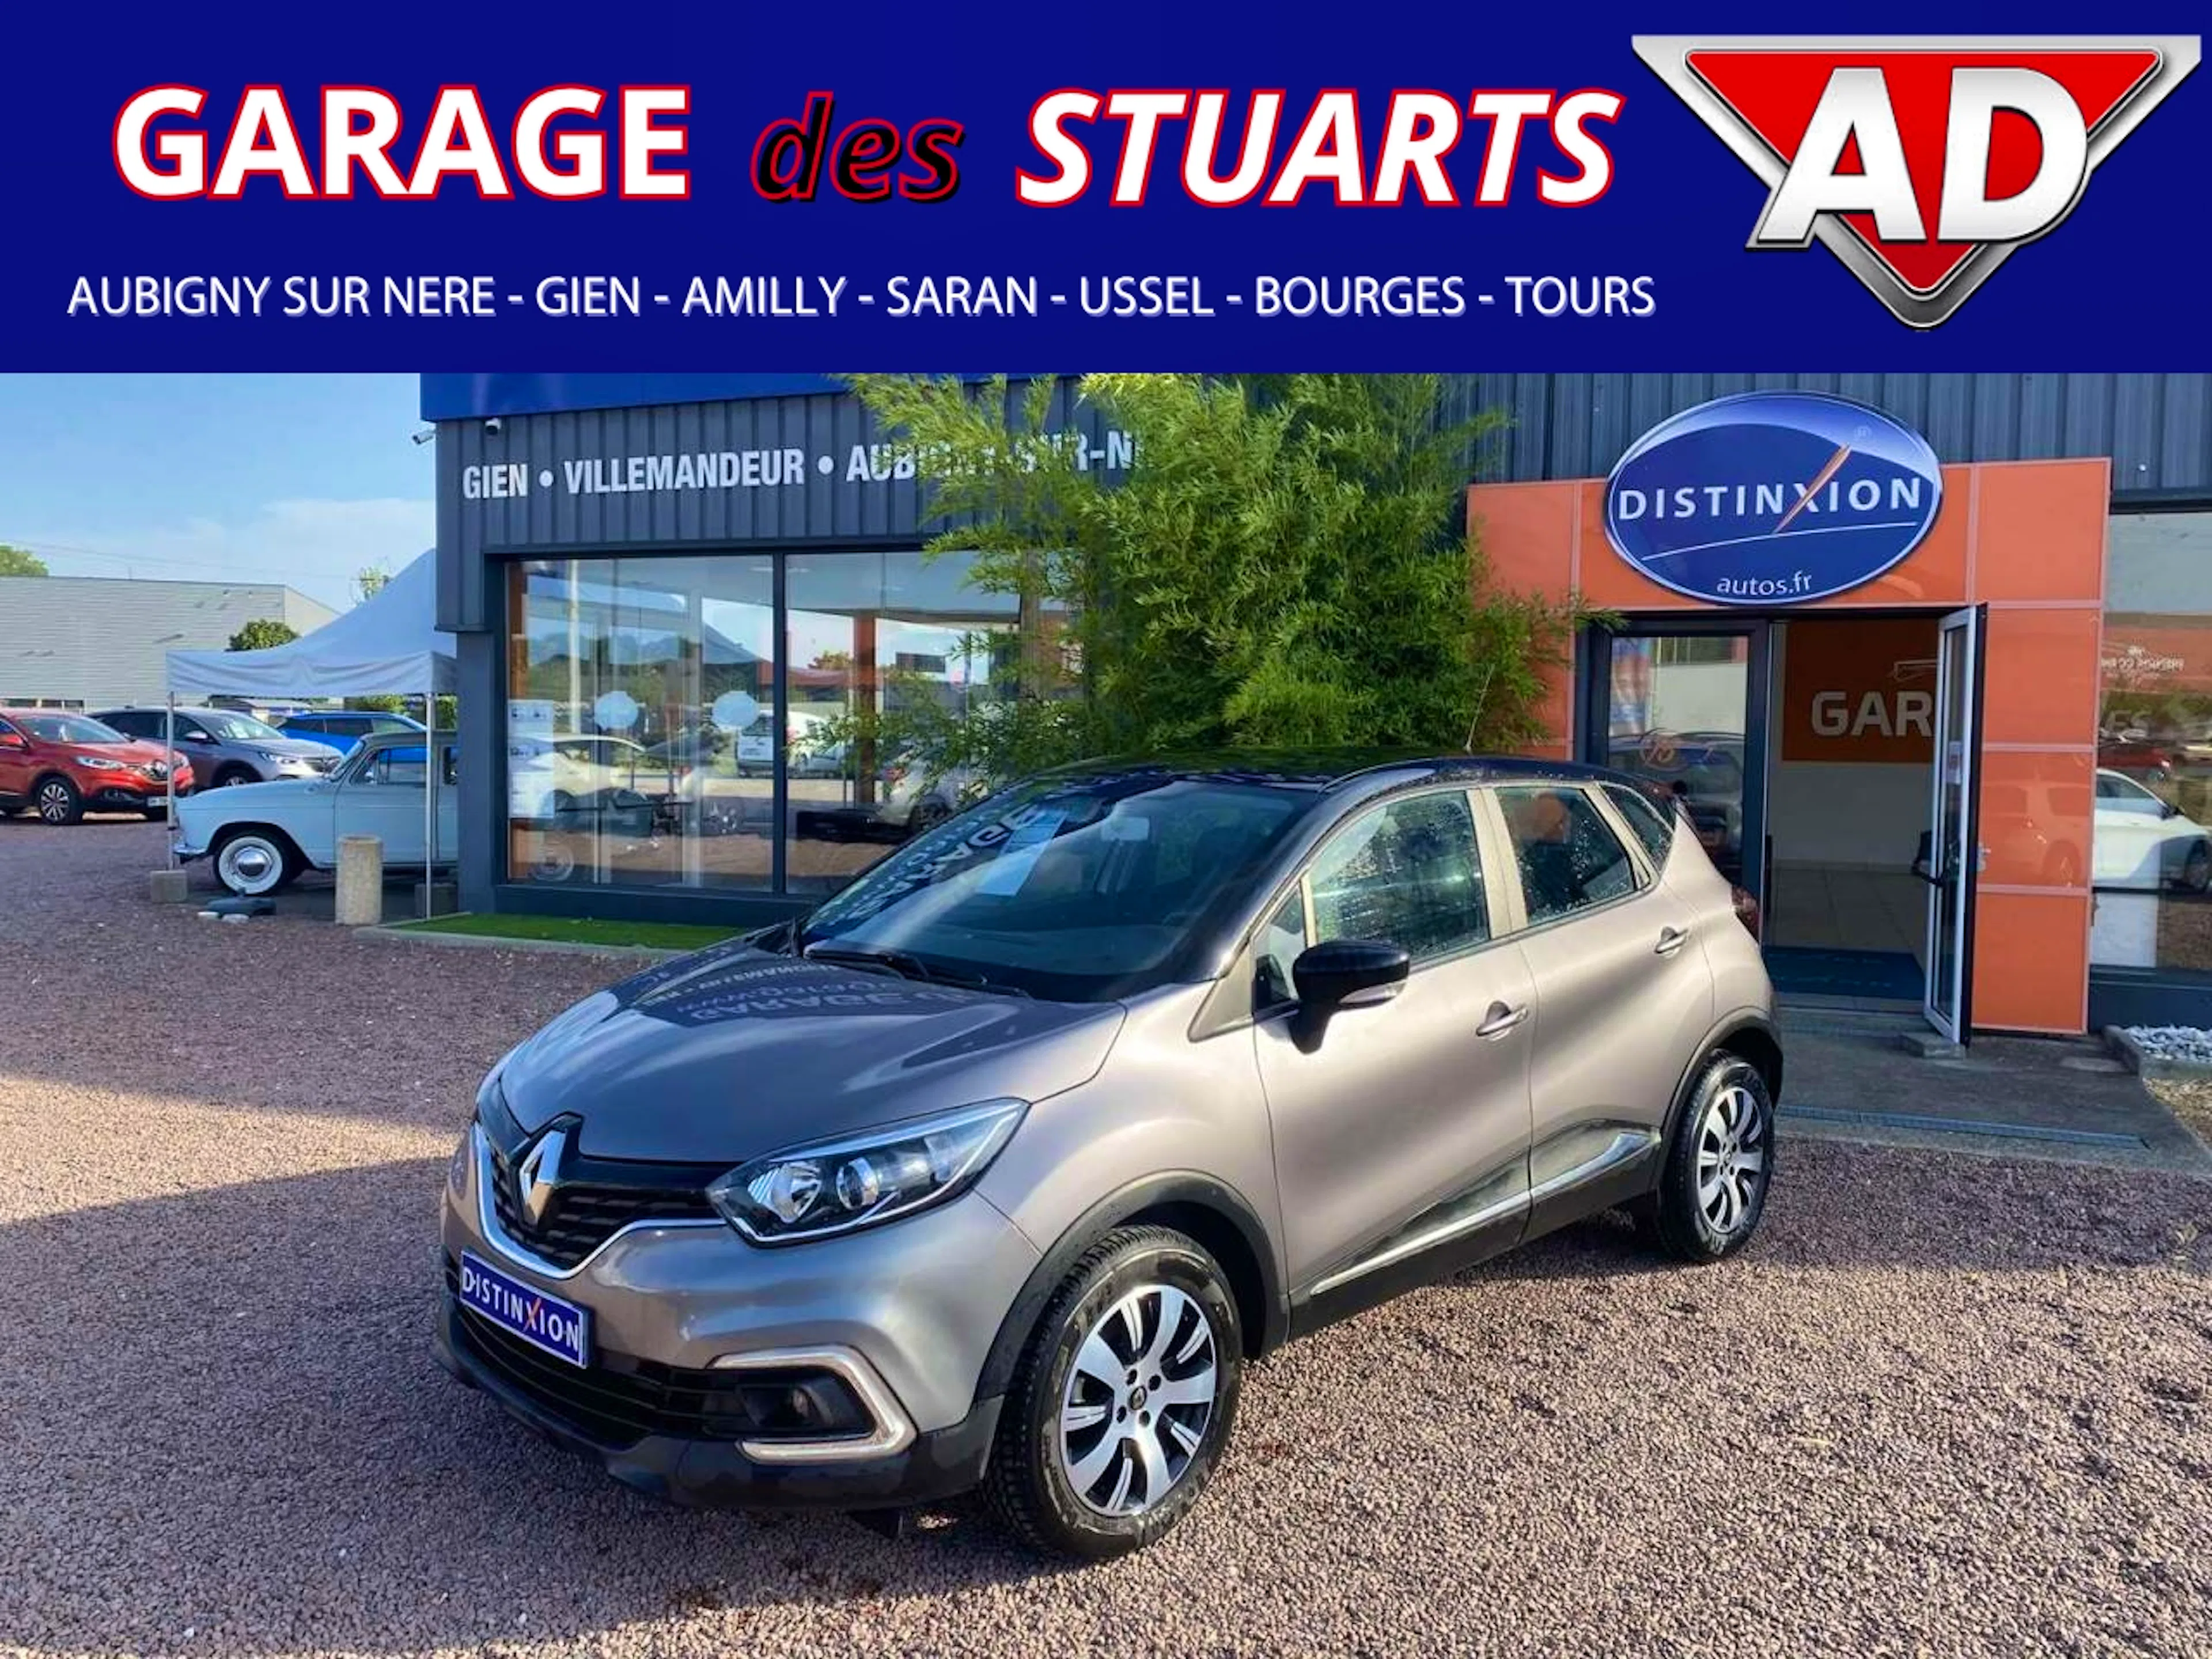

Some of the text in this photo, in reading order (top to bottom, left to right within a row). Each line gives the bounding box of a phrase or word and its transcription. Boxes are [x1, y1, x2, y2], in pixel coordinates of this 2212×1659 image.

[463, 463, 528, 499] GIEN
[564, 448, 805, 494] VILLEMANDEUR
[1618, 465, 1921, 525] DISTINXION
[1717, 570, 1812, 596] autos.fr
[1811, 690, 1936, 737] GAR
[462, 1267, 578, 1352] DISTINXION
